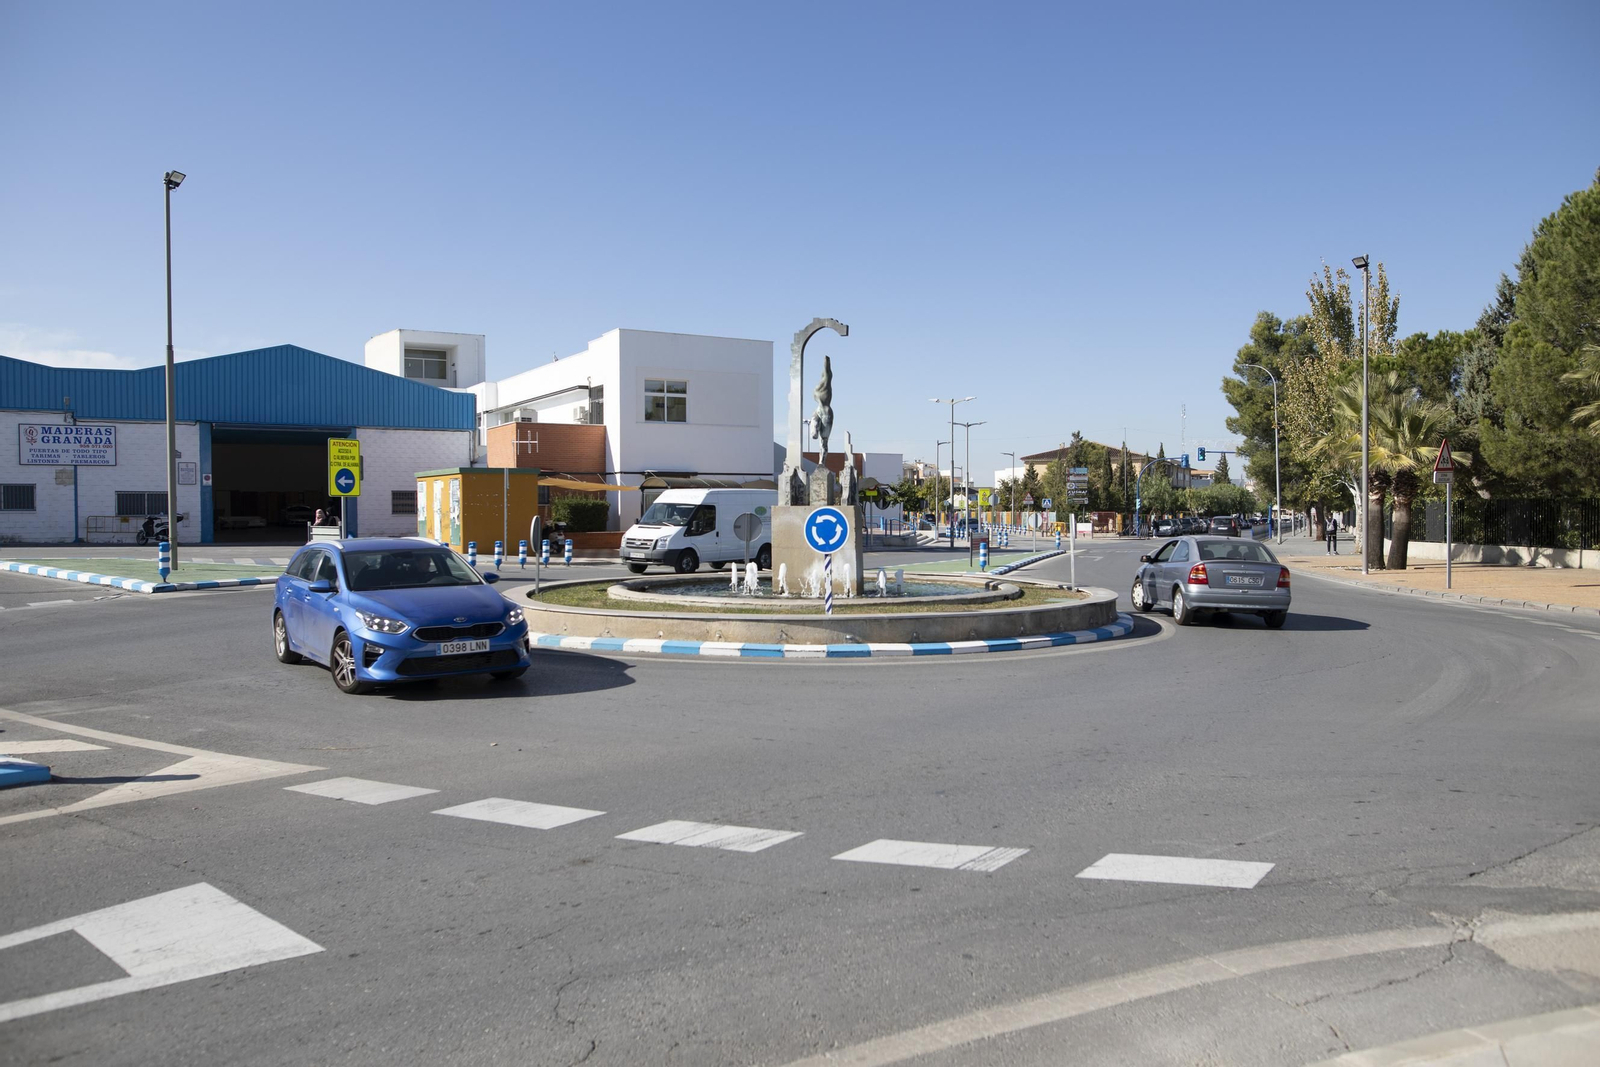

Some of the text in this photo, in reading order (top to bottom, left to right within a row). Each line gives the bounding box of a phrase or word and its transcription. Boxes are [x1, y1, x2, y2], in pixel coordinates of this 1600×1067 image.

[41, 426, 113, 436] MADERAS
[41, 435, 113, 445] GRANADA
[442, 640, 487, 654] 0398 LNN
